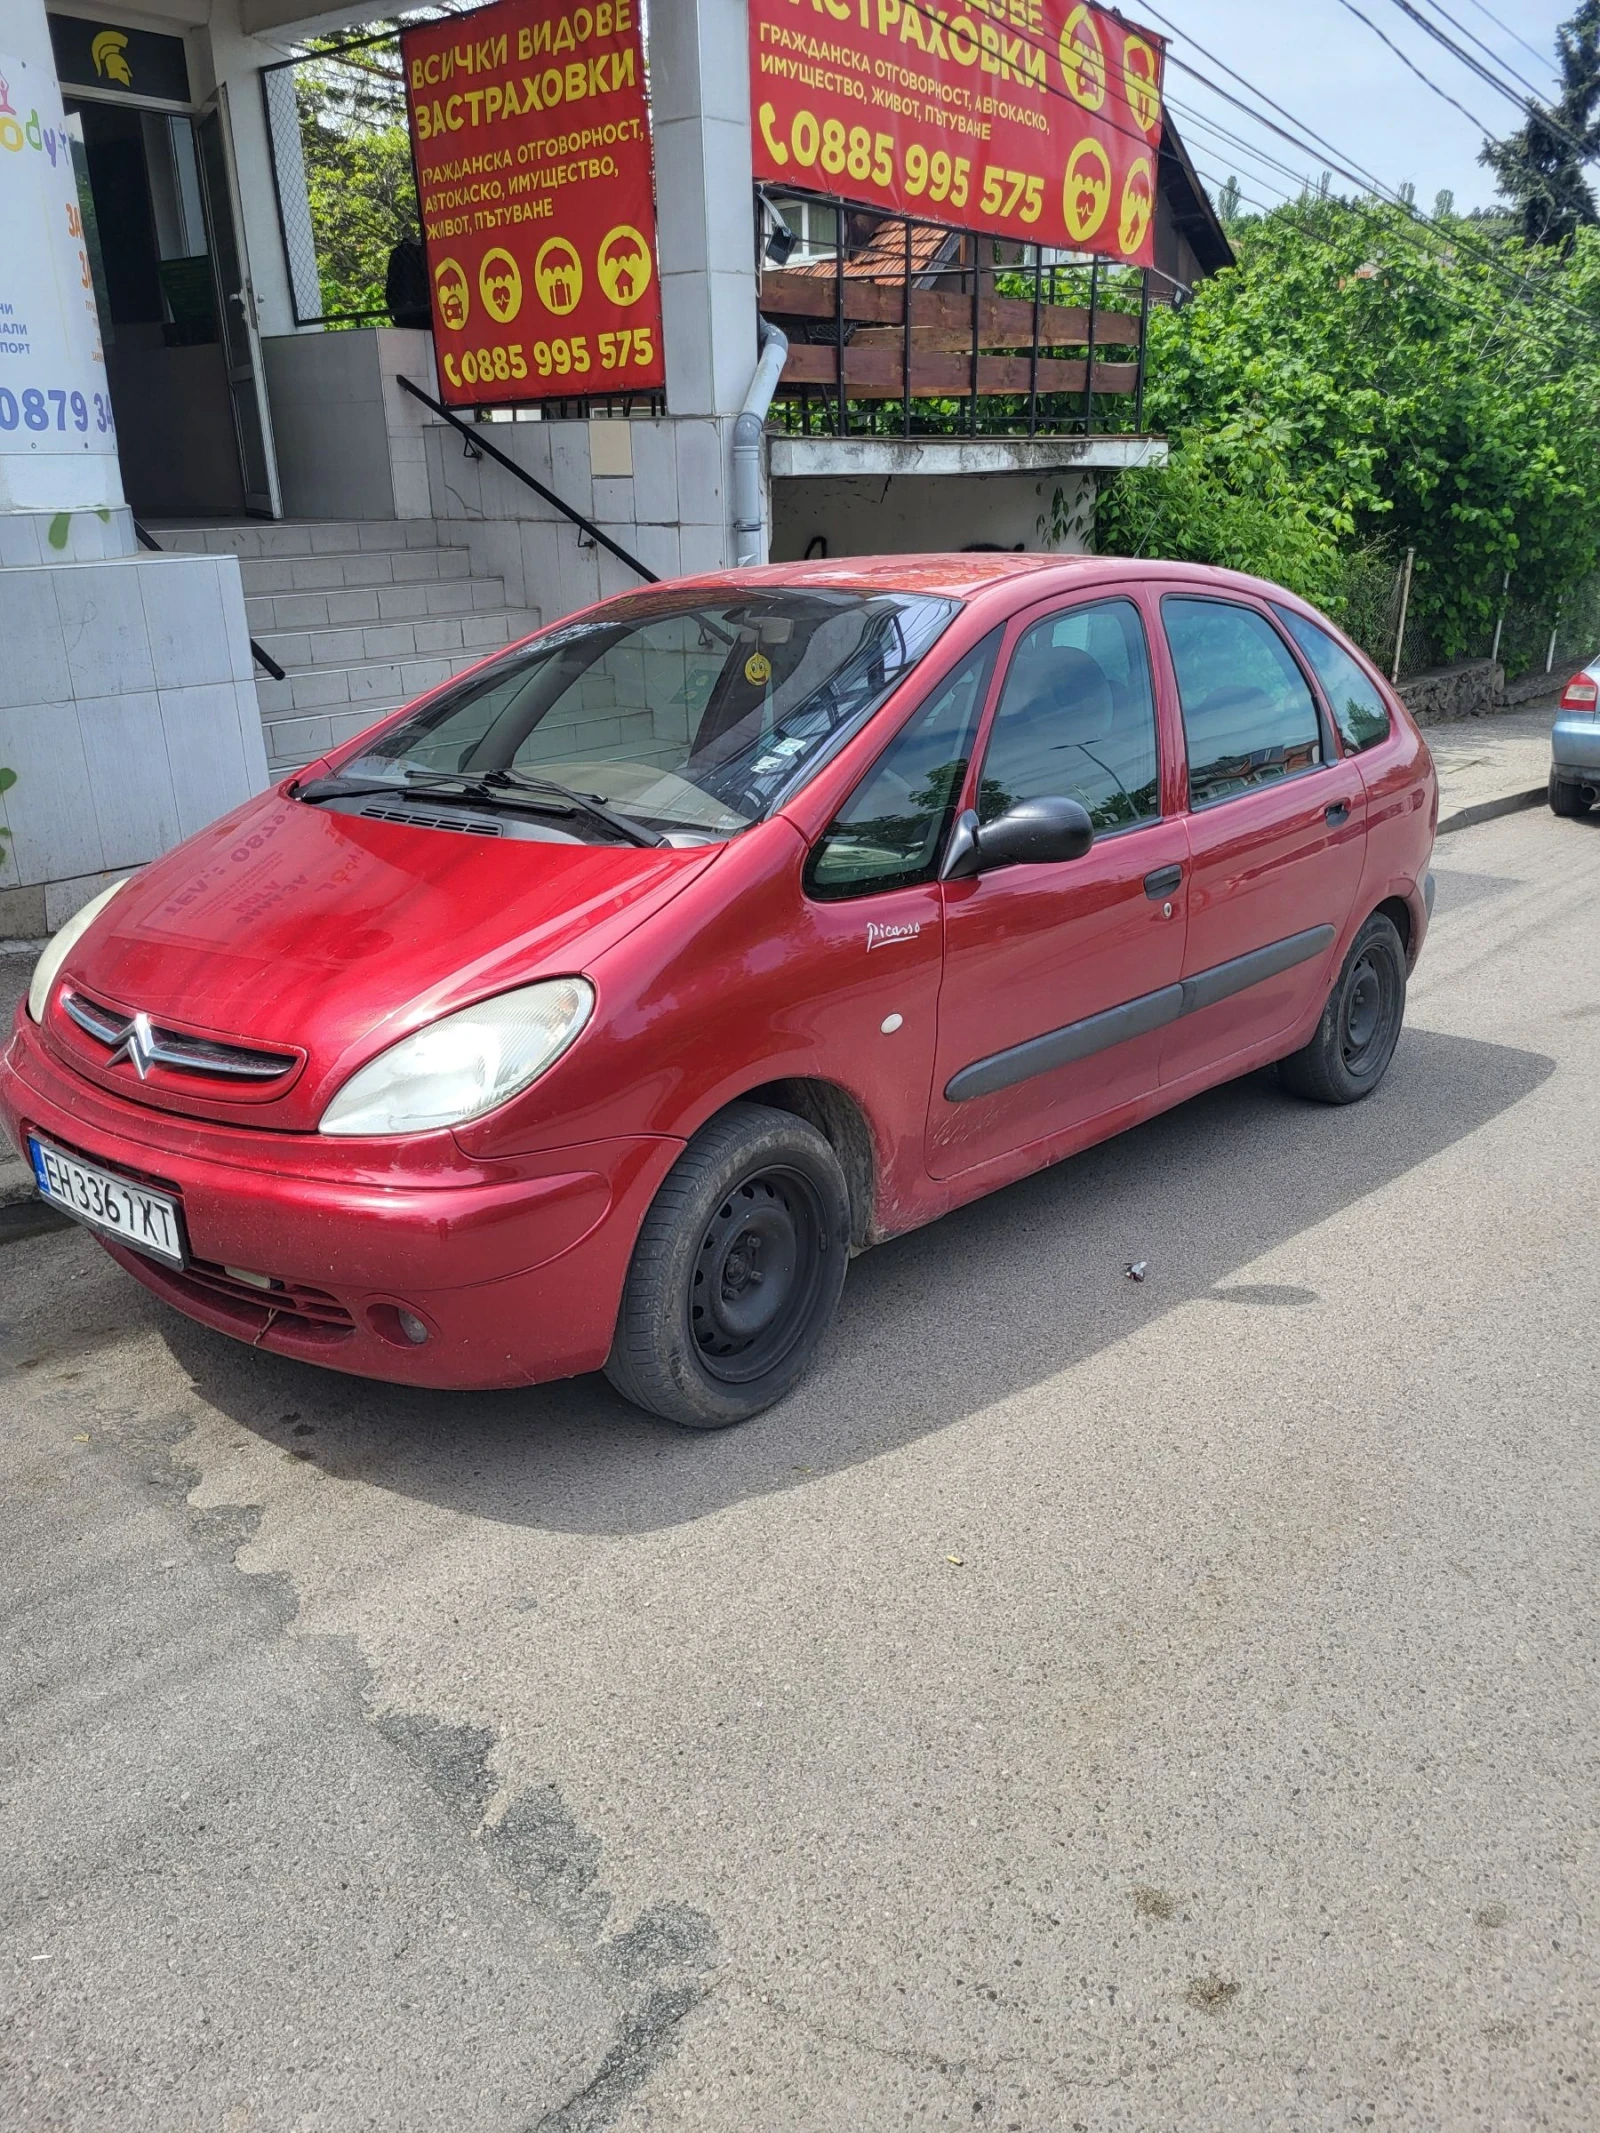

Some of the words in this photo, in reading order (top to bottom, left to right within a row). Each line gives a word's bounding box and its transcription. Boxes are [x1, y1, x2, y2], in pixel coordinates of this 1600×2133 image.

[412, 34, 507, 90] ВСИЧКИ
[518, 0, 632, 61] ВИДОВЕ
[415, 48, 636, 140] ЗАСТРАХОВКИ
[760, 22, 871, 74] ГРАЖДАНСКА
[874, 59, 972, 111] ОТГОВОРНОСТ,
[975, 96, 1050, 135] АВТОКАСКО,
[760, 53, 867, 105] ИМУЩЕСТВО,
[871, 86, 922, 123] ЖИВОТ,
[925, 105, 992, 141] ПЪТУВАНЕ
[422, 149, 513, 188] ГРАЖДАНСКА
[516, 118, 645, 165] ОТГОВОРНОСТ,
[424, 180, 505, 214] АВТОКАСКО,
[508, 156, 619, 196] ИМУЩЕСТВО,
[791, 110, 894, 187] 0885
[904, 144, 971, 208] 995
[979, 165, 1045, 223] 575
[426, 214, 473, 241] ЖИВОТ,
[474, 198, 554, 231] ПЪТУВАНЕ
[0, 322, 28, 335] АЛИ
[461, 344, 528, 383] 0885
[533, 336, 591, 376] 995
[598, 328, 654, 369] 575
[0, 387, 89, 432] 0879
[866, 922, 921, 953] Picasso
